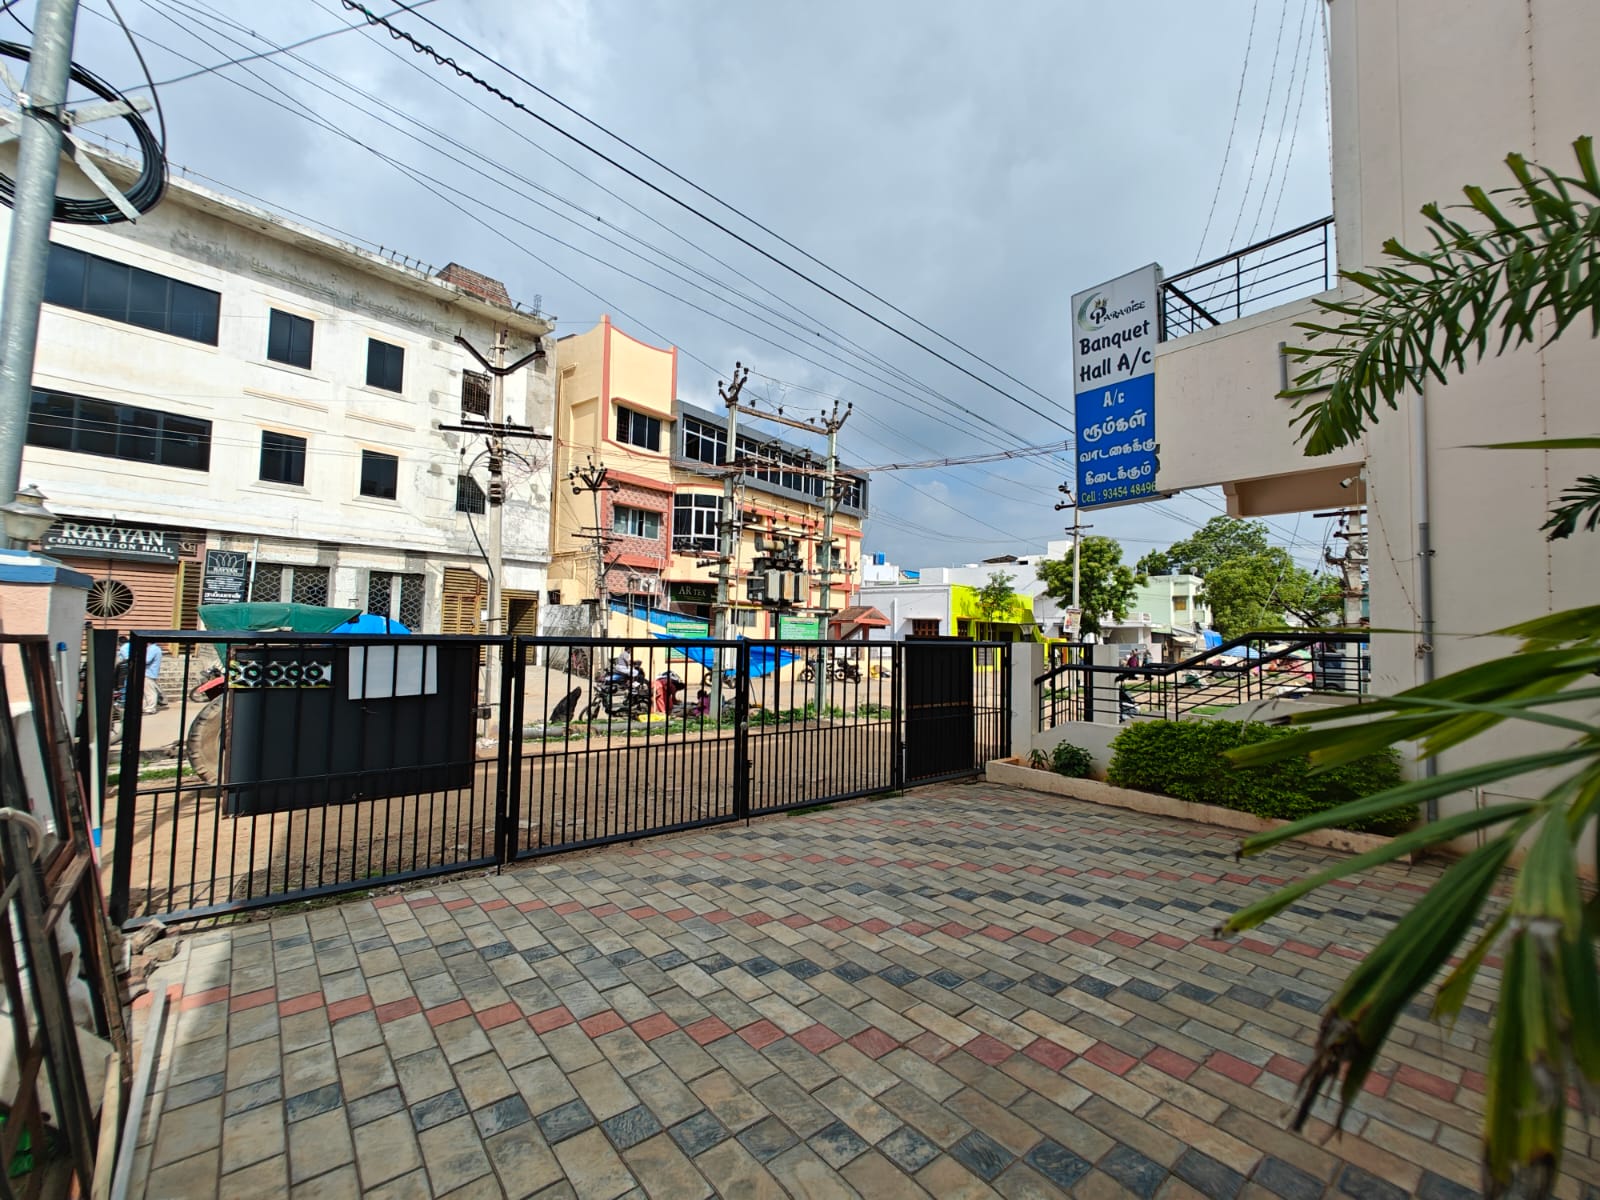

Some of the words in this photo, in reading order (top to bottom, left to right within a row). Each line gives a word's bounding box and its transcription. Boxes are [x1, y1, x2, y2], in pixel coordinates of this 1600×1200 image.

[1079, 319, 1150, 355] Banquet
[1080, 357, 1111, 382] Hall
[1103, 388, 1125, 407] A/c
[1083, 408, 1148, 442] ரூம்கள்
[1085, 460, 1151, 485] கிடைக்கும்
[1081, 491, 1096, 503] Cell
[1103, 486, 1128, 500] 93454
[47, 536, 137, 551] CONVENTION
[141, 545, 174, 554] HALL
[61, 522, 165, 546] RAYYAN
[678, 585, 692, 596] AR
